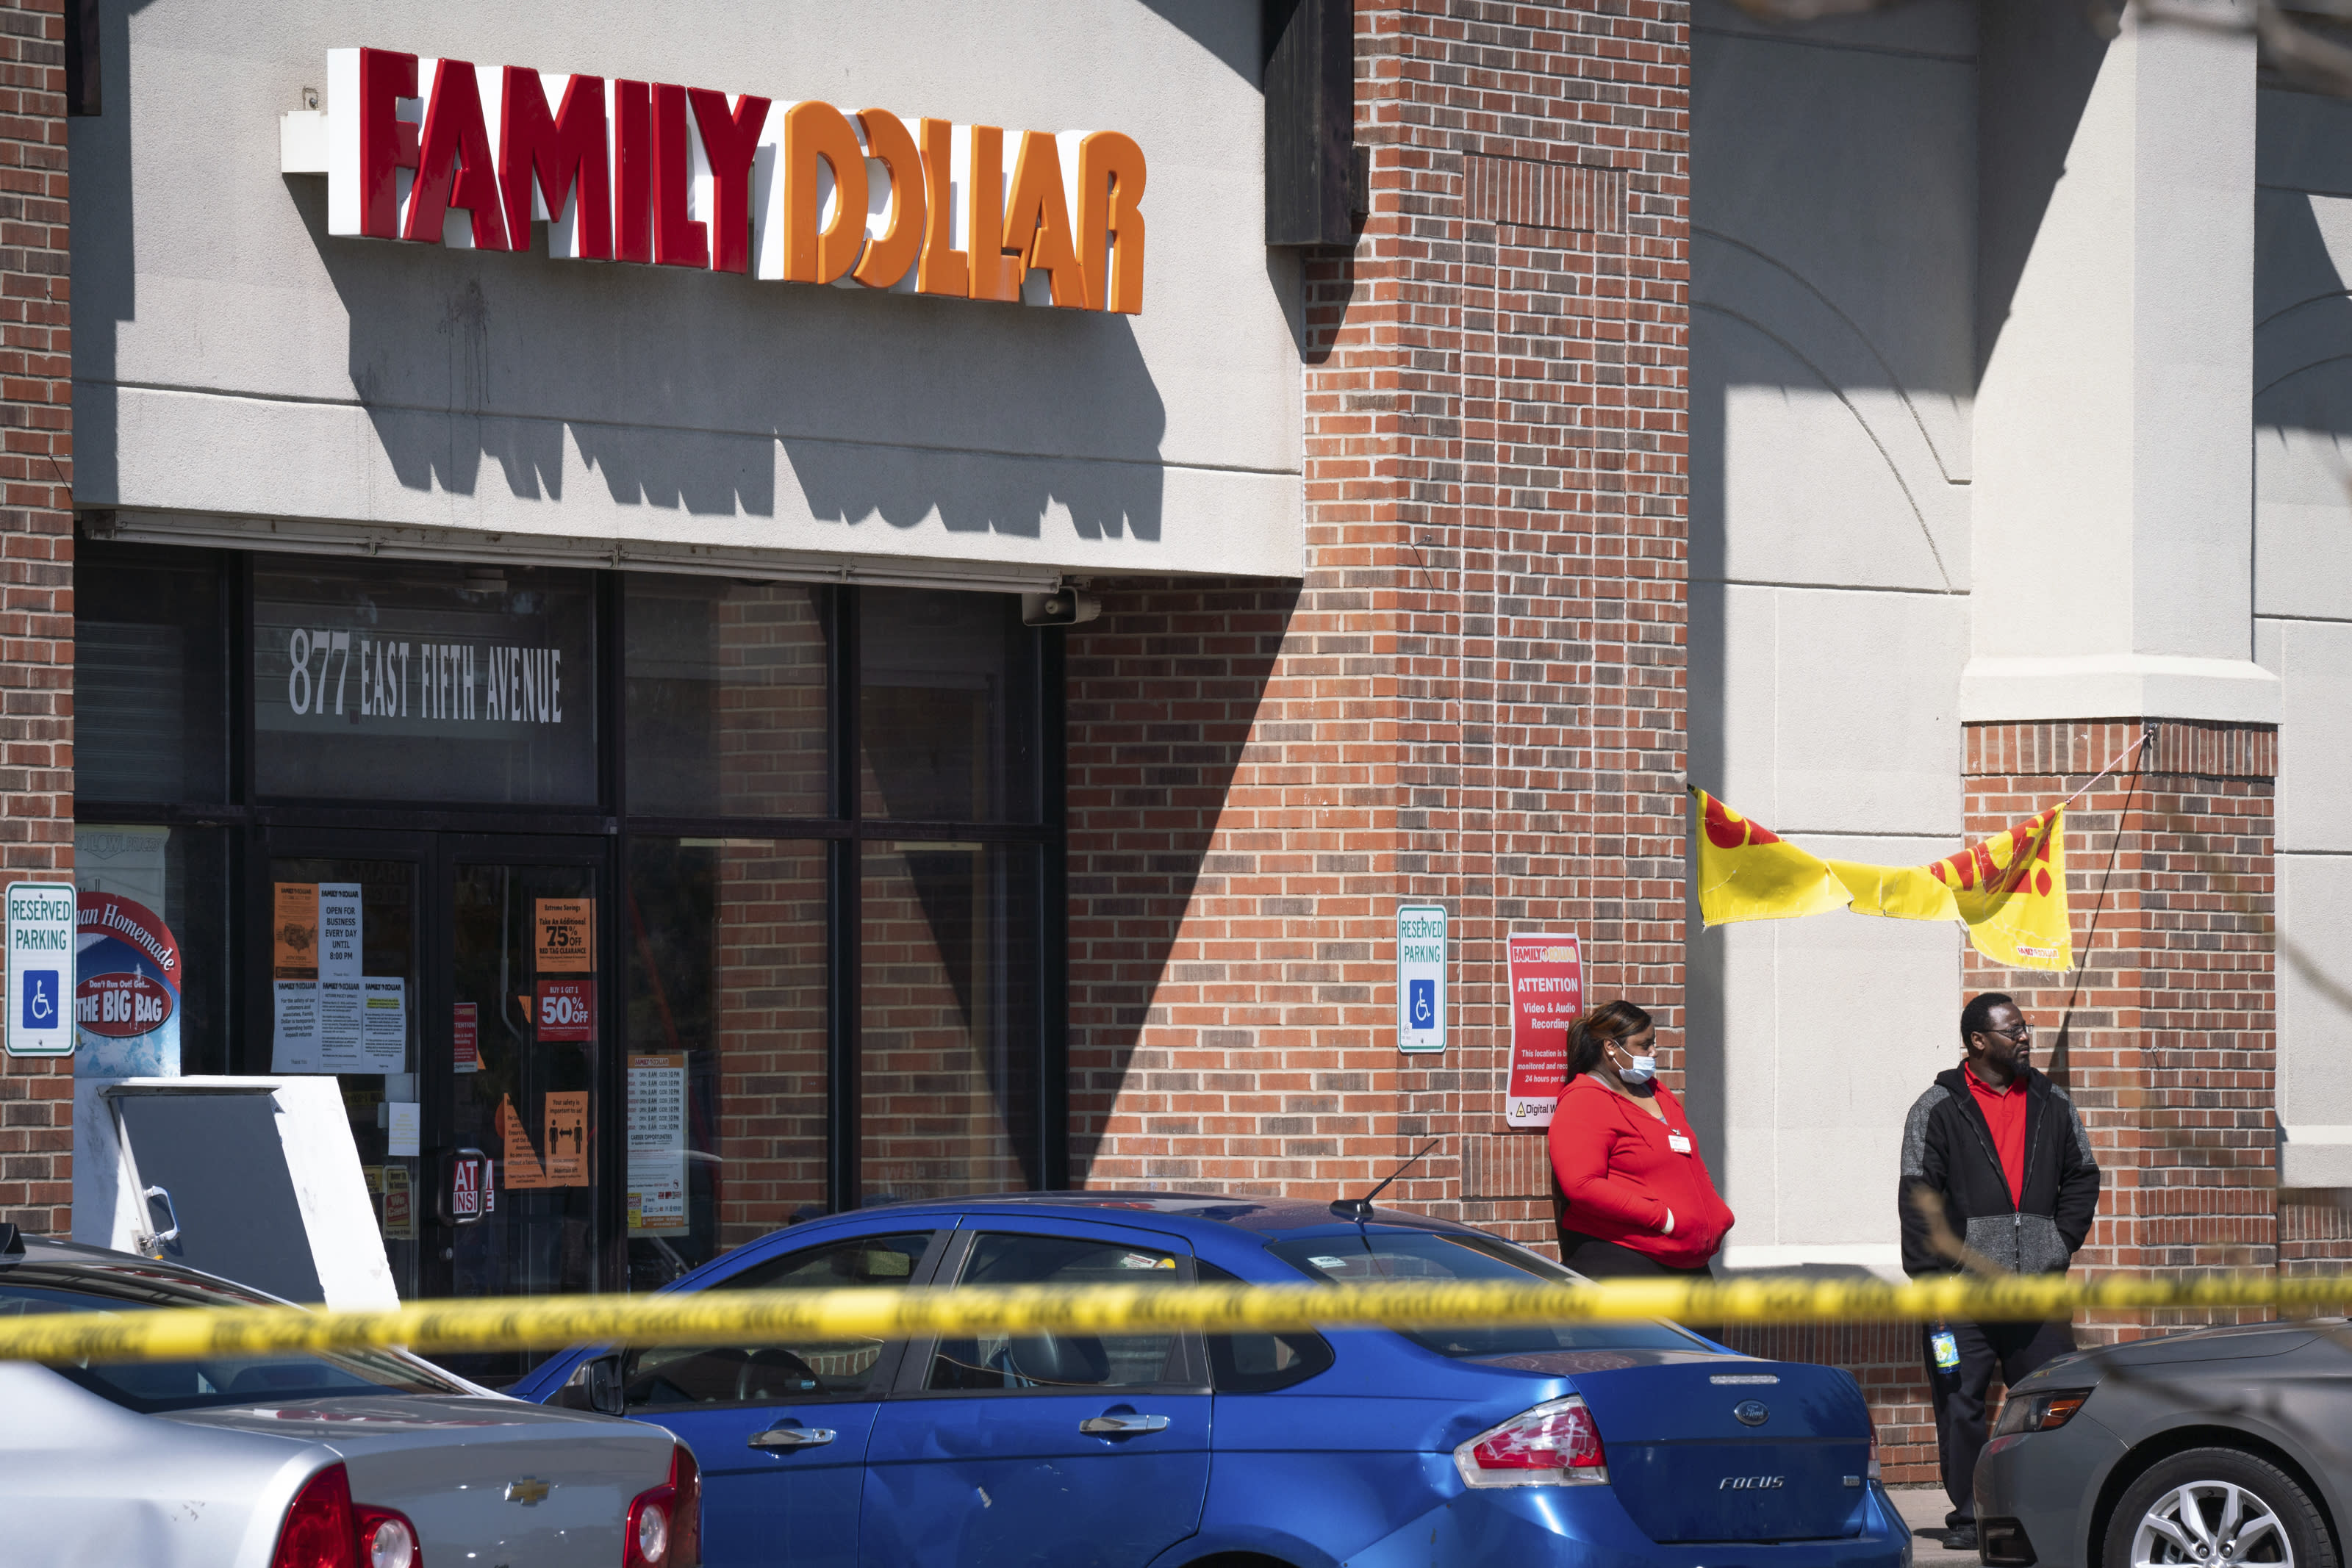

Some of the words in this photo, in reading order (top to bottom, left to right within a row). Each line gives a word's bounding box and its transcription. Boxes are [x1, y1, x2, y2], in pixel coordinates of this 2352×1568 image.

[360, 47, 772, 275] FAMILY
[784, 100, 1147, 315] DOLLAR
[289, 628, 350, 714] 877
[361, 640, 409, 717] EAST
[422, 644, 475, 720] FIFTH
[487, 647, 562, 723] AVENUE
[12, 900, 71, 921] RESERVED
[326, 907, 343, 915] OPEN
[344, 907, 355, 915] FOR
[564, 905, 581, 913] Savings
[559, 917, 586, 925] Additional
[1402, 921, 1443, 938] RESERVED
[15, 929, 67, 950] PARKING
[101, 904, 175, 971] Homemade
[570, 937, 582, 946] OFF
[332, 941, 350, 949] UNTIL
[1405, 945, 1440, 963] PARKING
[1513, 946, 1541, 962] FAMILY
[89, 980, 105, 988] Don't
[107, 980, 118, 988] Run
[120, 980, 132, 988] Out!
[1518, 977, 1578, 992] ATTENTION
[76, 994, 99, 1022] THE
[103, 989, 132, 1023] BIG
[135, 993, 162, 1022] BAG
[1523, 1003, 1545, 1013] Video
[1547, 1003, 1553, 1013] &
[1555, 1003, 1576, 1013] Audio
[572, 1011, 589, 1023] OFF
[1532, 1018, 1569, 1031] Recording
[1521, 1049, 1534, 1057] This
[1535, 1049, 1556, 1057] location
[1557, 1049, 1562, 1057] is
[1527, 1104, 1549, 1116] Digital
[390, 1195, 405, 1206] We
[454, 1192, 492, 1212] INSIE
[388, 1204, 408, 1217] Card
[1743, 1405, 1763, 1417] Ford
[1719, 1475, 1785, 1489] FOCUS
